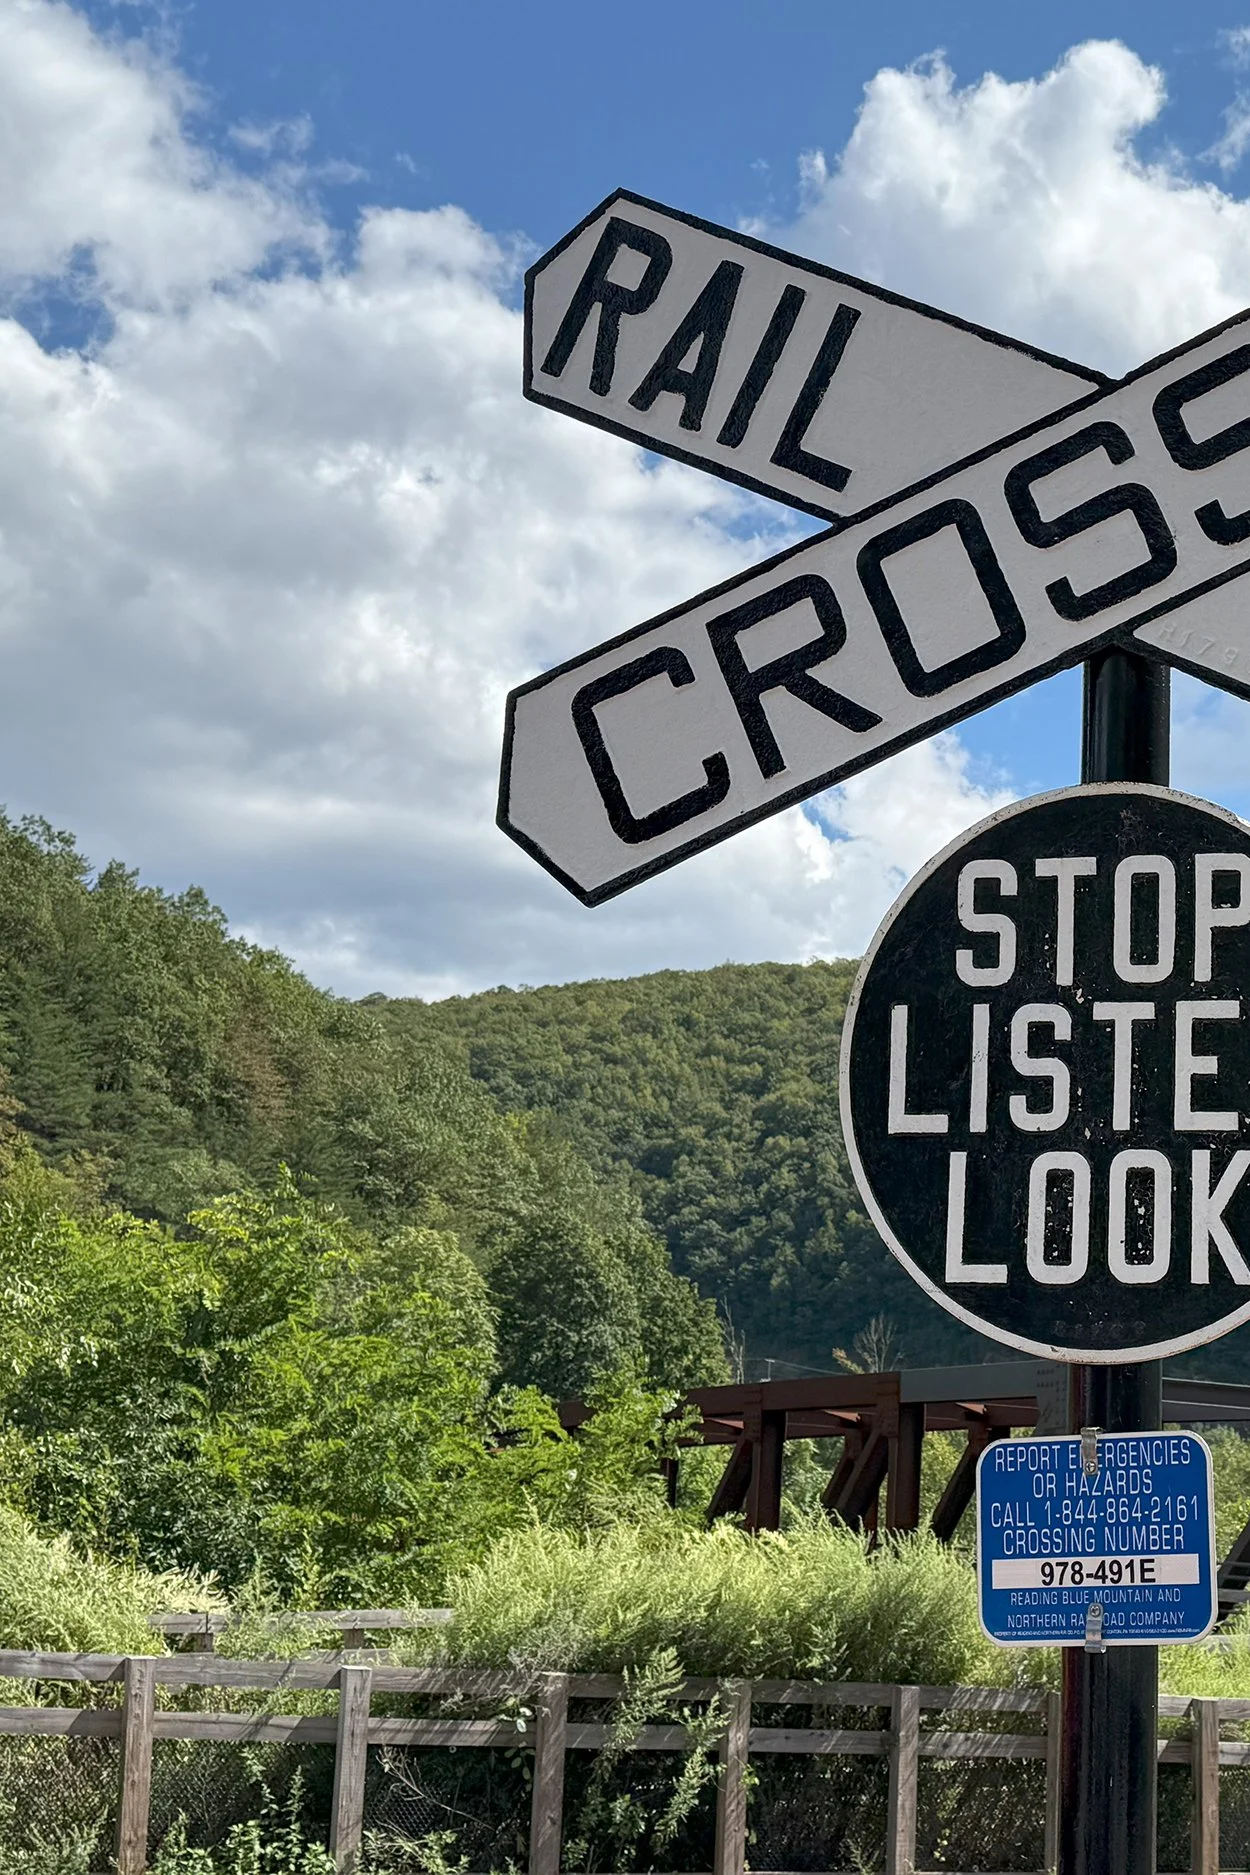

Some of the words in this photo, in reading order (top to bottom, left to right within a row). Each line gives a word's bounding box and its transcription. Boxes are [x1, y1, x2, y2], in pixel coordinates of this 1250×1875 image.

[539, 215, 862, 493] RAIL
[995, 1445, 1060, 1472] REPORT
[1068, 1439, 1191, 1469] EERGENCIES
[1033, 1473, 1056, 1498] OR
[1065, 1470, 1152, 1497] HAZARDS
[991, 1502, 1035, 1528] CALL
[1045, 1495, 1199, 1525] 1-844-864-2161
[1003, 1527, 1095, 1555] CROSSING
[1104, 1524, 1184, 1551] NUMBER
[1040, 1558, 1156, 1586] 978-491E
[1010, 1591, 1057, 1606] READING
[1062, 1590, 1089, 1605] BLUE
[1094, 1589, 1153, 1603] MOUNTAIN
[1158, 1588, 1181, 1602] AND
[1007, 1613, 1066, 1628] NORTHERN
[1070, 1612, 1125, 1627] RAOAD
[1130, 1611, 1185, 1626] COMPANY
